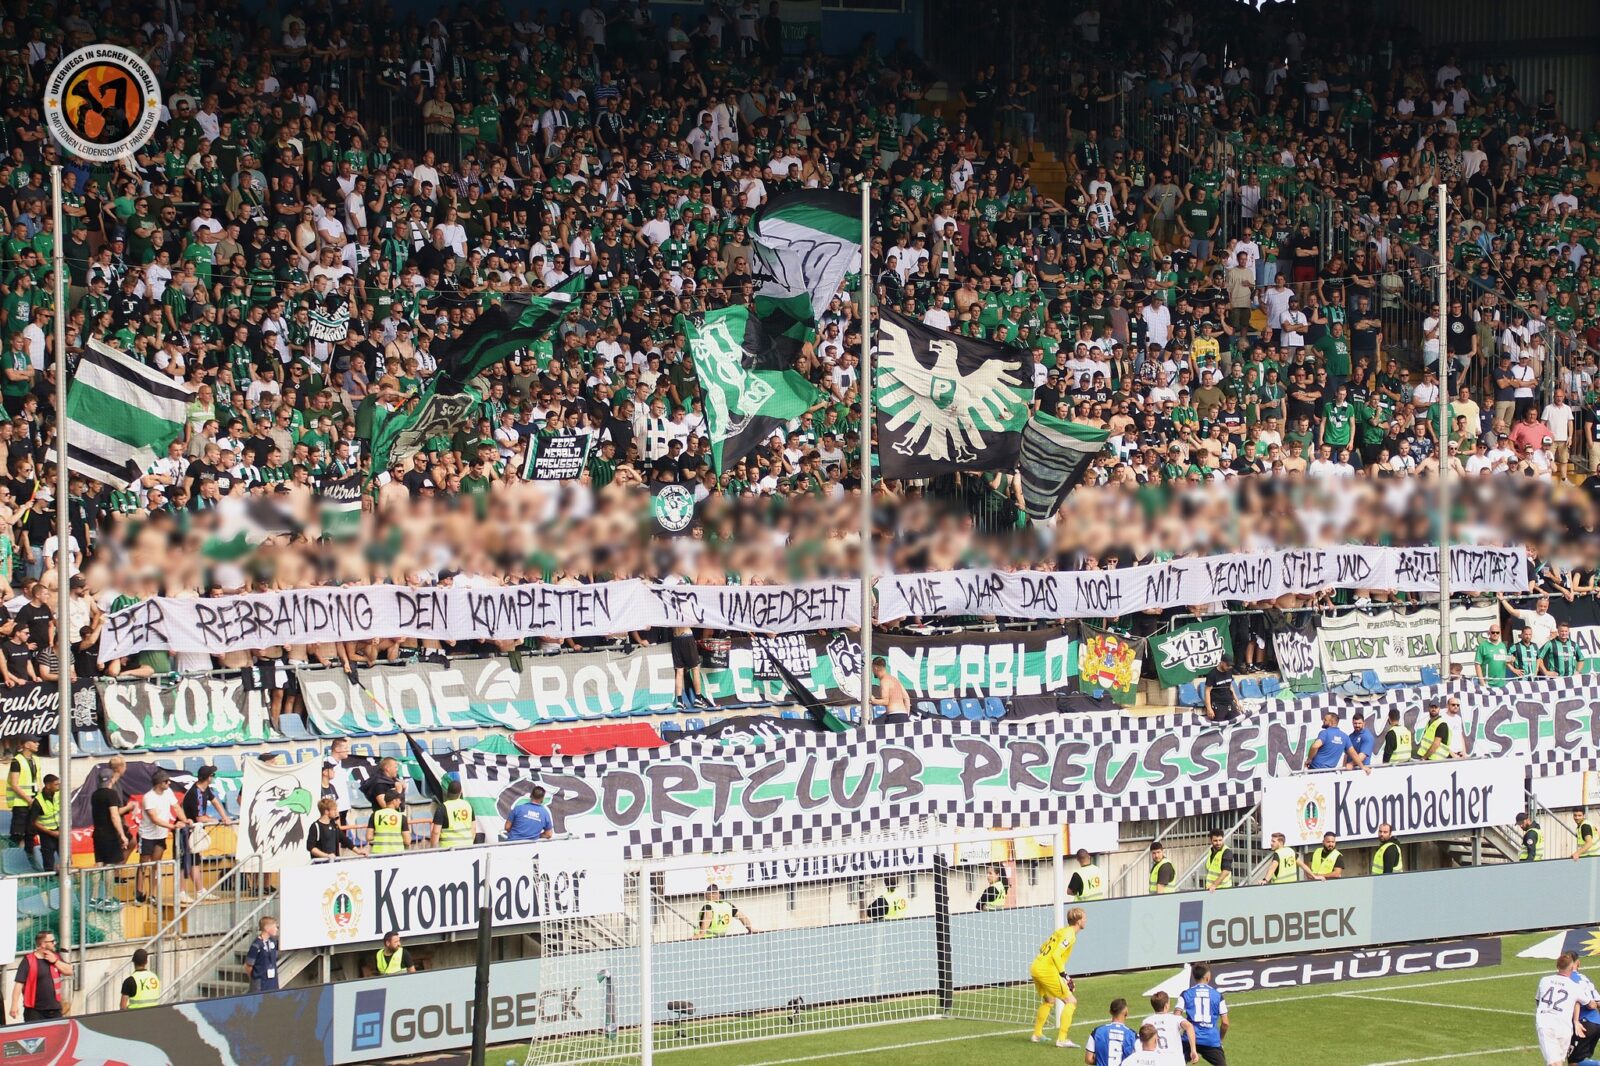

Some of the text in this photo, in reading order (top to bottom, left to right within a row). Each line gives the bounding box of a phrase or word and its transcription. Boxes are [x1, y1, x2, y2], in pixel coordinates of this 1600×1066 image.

[440, 403, 461, 416] SCP
[535, 457, 584, 469] PREUSSEN
[543, 447, 581, 458] NERBLO
[536, 467, 579, 479] MÜNSTER
[107, 598, 168, 645] PER
[195, 592, 374, 645] REBRANDING
[395, 590, 448, 631] DEN
[467, 587, 612, 637] KOMPLETTEN
[719, 584, 851, 628] UMGEDREHT
[896, 576, 947, 615] WIE
[956, 572, 1005, 610] WAR
[1020, 575, 1058, 612] DAS
[1075, 574, 1122, 611] NOCH
[1146, 565, 1189, 605] MIT
[1206, 557, 1273, 596] VECCHIO
[1282, 551, 1326, 589] STILE
[1336, 553, 1372, 583] UND
[1325, 635, 1390, 662] WEST
[753, 658, 810, 672] VEBOT
[888, 635, 1069, 699] NERBLO
[952, 721, 1309, 803] PREUSSEN
[453, 809, 468, 821] K9
[1334, 771, 1494, 838] Krombacher
[378, 814, 398, 826] K9
[374, 852, 588, 935] Krombacher
[1087, 877, 1101, 890] K9
[1206, 906, 1357, 950] GOLDBECK
[140, 977, 158, 990] K9
[1214, 948, 1480, 993] SCHÜCO
[1194, 997, 1212, 1024] 11
[1541, 986, 1569, 1013] 42
